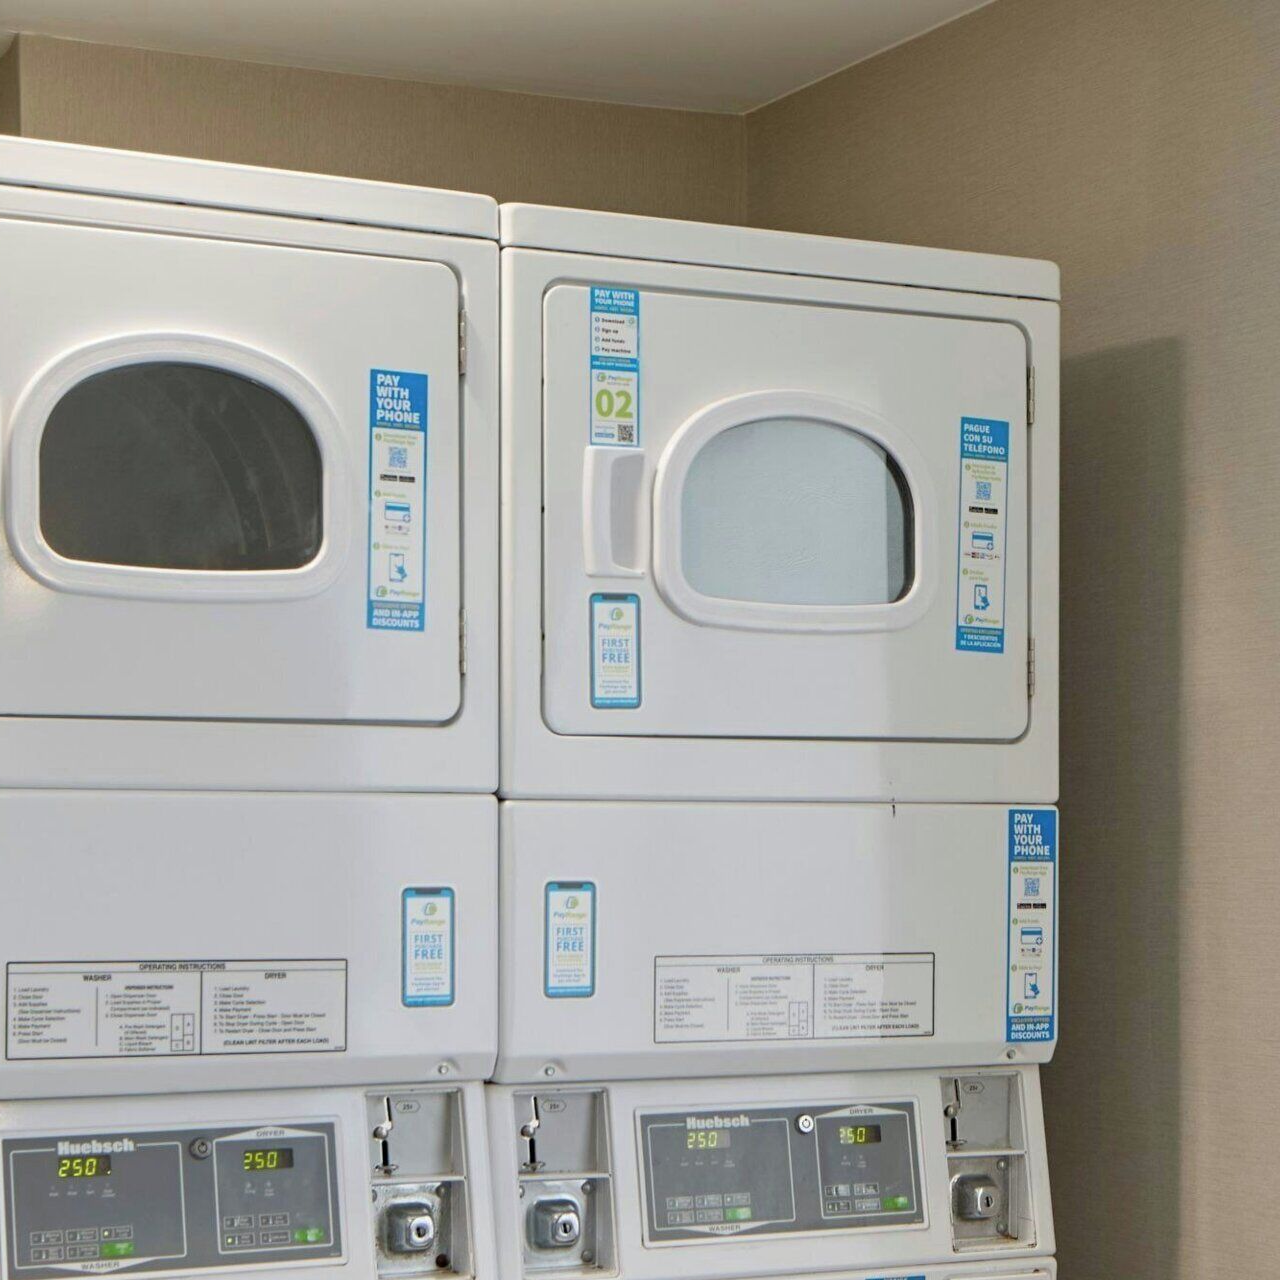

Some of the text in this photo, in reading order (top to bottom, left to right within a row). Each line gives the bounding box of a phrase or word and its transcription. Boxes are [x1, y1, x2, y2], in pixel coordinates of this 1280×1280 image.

[594, 289, 635, 300] PAY WITH
[377, 374, 400, 386] PAY
[377, 386, 409, 399] WITH
[377, 397, 411, 411] YOUR
[596, 389, 633, 418] 02
[377, 410, 420, 424] PHONE
[964, 423, 990, 433] PAGUE
[964, 434, 992, 444] CON SU
[964, 443, 1004, 454] TELÉFONO
[374, 609, 419, 619] AND IN-APP
[372, 618, 419, 628] DISCOUNTS
[602, 638, 629, 648] FIRST
[602, 653, 630, 663] FREE
[1015, 814, 1033, 823] PAY
[1014, 824, 1040, 834] WITH
[1014, 834, 1042, 845] YOUR
[1014, 845, 1050, 856] PHONE
[557, 927, 584, 936] FIRST
[414, 934, 443, 943] FIRST
[557, 942, 584, 952] FREE
[414, 949, 443, 960] FREE
[1012, 1023, 1049, 1031] AND IN-APP
[1011, 1031, 1050, 1040] DISCOUNTS
[686, 1114, 750, 1129] Huebsch
[256, 1130, 285, 1138] DRYER
[688, 1132, 717, 1148] 250
[58, 1139, 135, 1156] Huebsch
[244, 1151, 276, 1170] 250
[58, 1158, 96, 1177] 250
[709, 1224, 741, 1232] WASHER
[81, 1261, 120, 1271] WASHER
